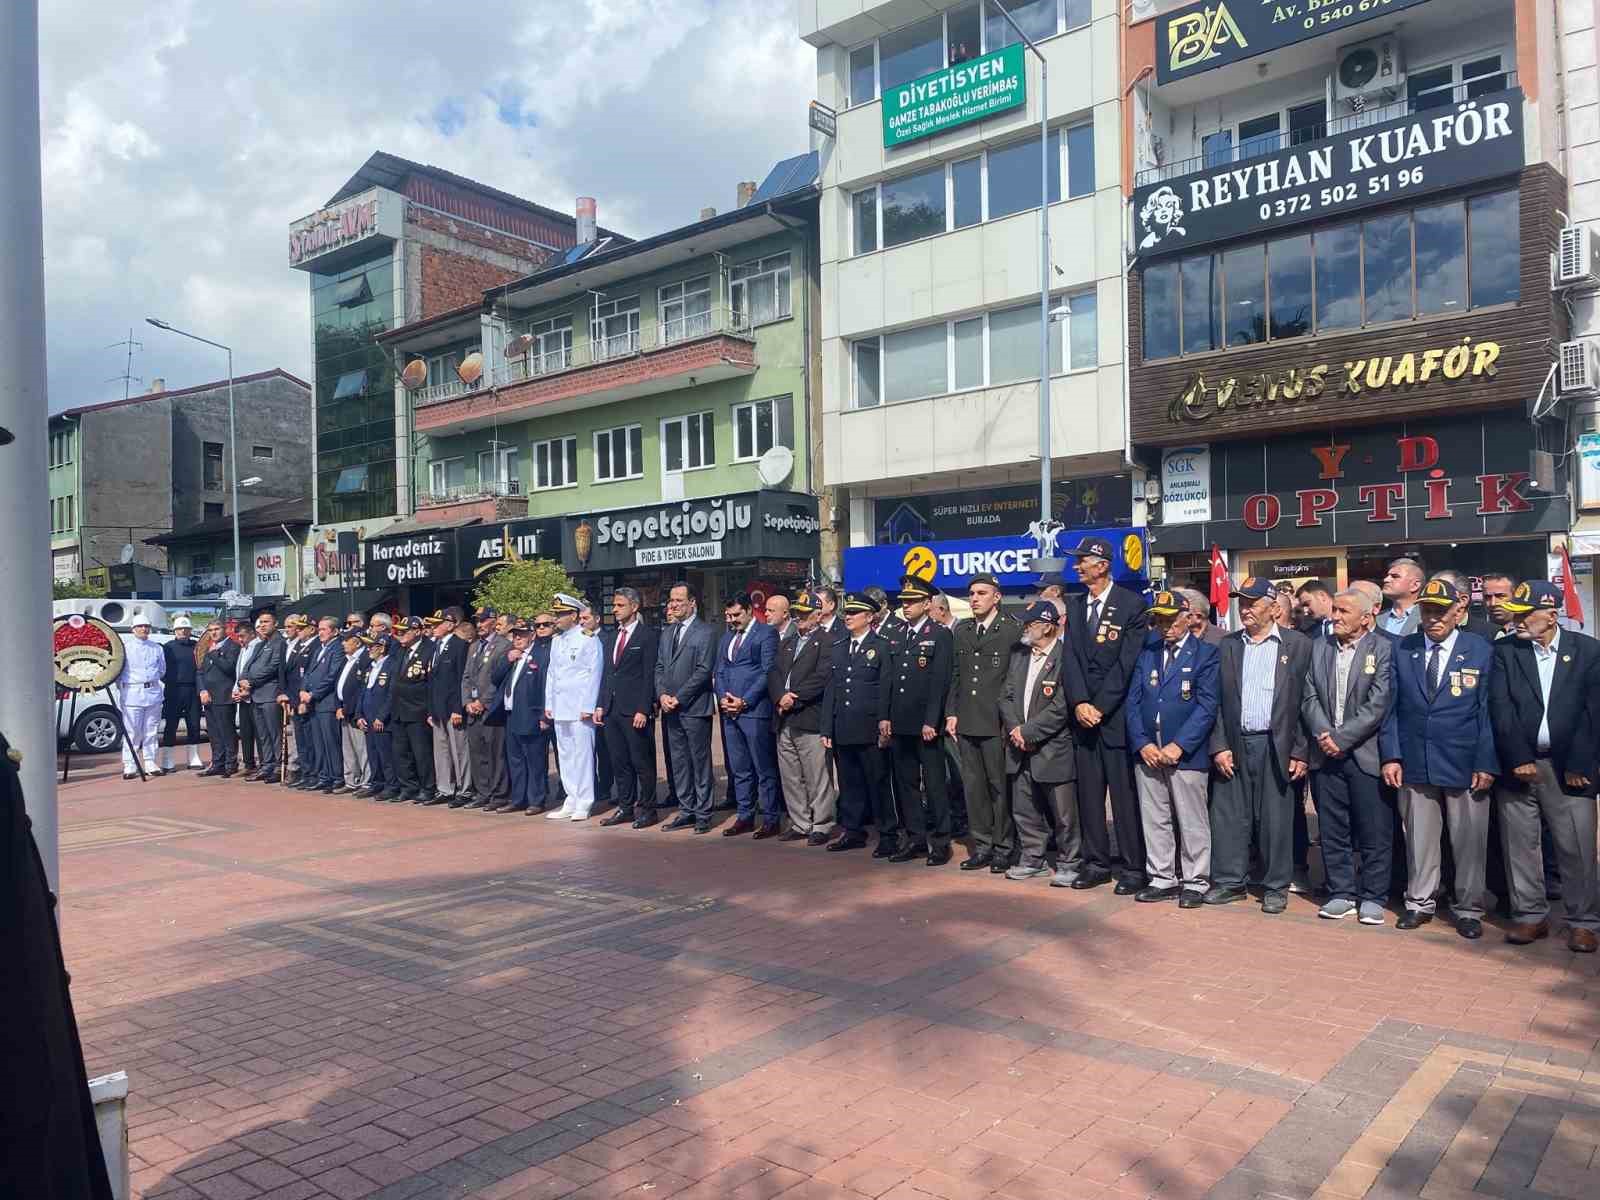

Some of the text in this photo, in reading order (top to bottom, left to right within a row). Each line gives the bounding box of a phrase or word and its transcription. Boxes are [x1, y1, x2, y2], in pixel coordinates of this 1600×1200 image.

[1272, 5, 1302, 23] Av.
[1304, 17, 1314, 28] 0
[1320, 5, 1353, 24] 540
[899, 56, 1004, 108] DİYETİSYEN
[889, 75, 1018, 129] GAMZE TABAKOĞLU VERİMBAŞ
[896, 126, 911, 138] Özel
[936, 110, 960, 125] Meslek
[962, 101, 987, 117] Hizmet
[989, 93, 1012, 108] Birimi
[1190, 101, 1512, 212] REYHAN KUAFÖR
[1321, 184, 1358, 206] 502
[1368, 174, 1390, 196] 51
[1399, 166, 1424, 188] 96
[1344, 337, 1500, 393] KUAFÖR
[1168, 456, 1194, 473] SGK
[934, 504, 958, 516] SÜPER
[959, 502, 980, 514] HIZLI
[981, 502, 992, 513] EV
[1244, 469, 1534, 532] OPTİK
[597, 499, 751, 548] Sepetçioğlu
[764, 513, 820, 535] Sepetçioğlu
[967, 514, 1001, 526] BURADA
[372, 535, 442, 560] Karadeniz
[641, 551, 656, 563] PİDE
[664, 546, 686, 561] YEMEK
[687, 544, 715, 559] SALONU
[256, 552, 281, 569] ONUR
[387, 560, 425, 584] Optik
[939, 548, 1039, 575] TURKCE
[258, 573, 280, 582] TEKEL
